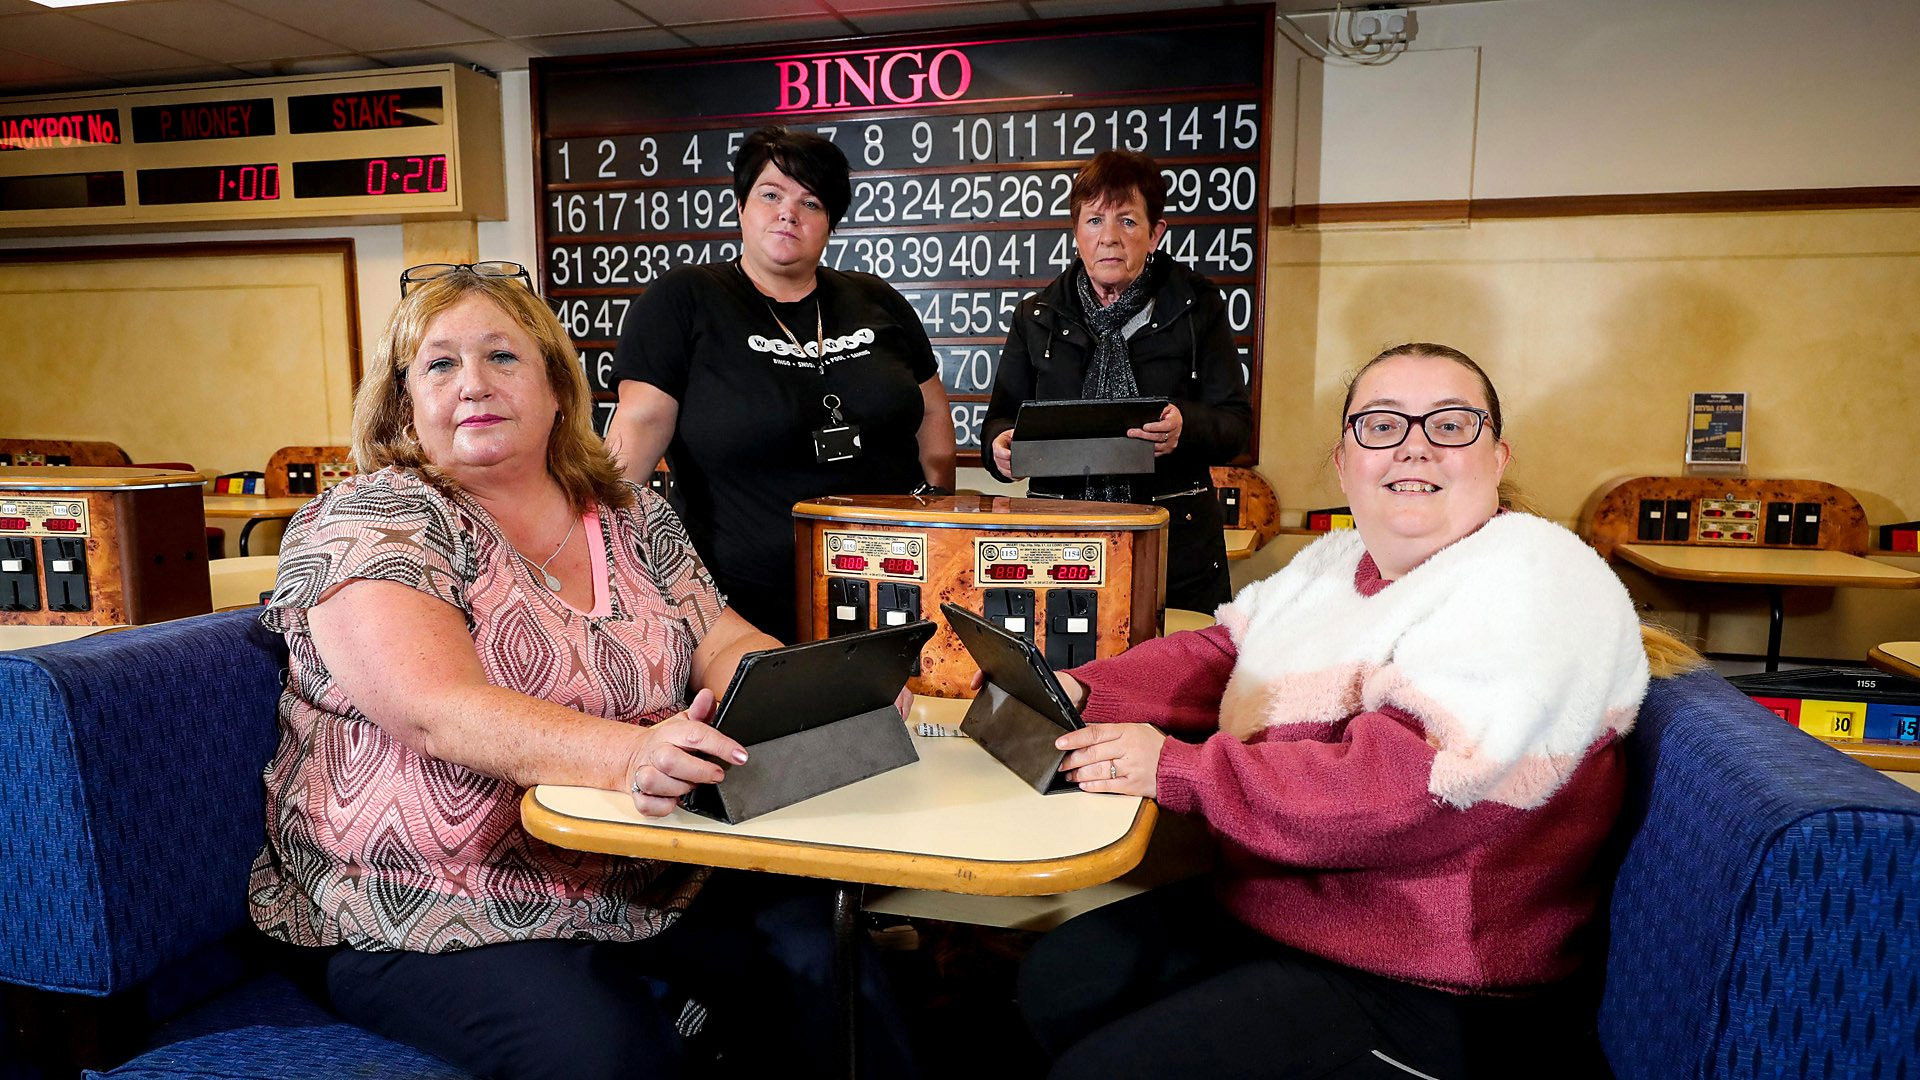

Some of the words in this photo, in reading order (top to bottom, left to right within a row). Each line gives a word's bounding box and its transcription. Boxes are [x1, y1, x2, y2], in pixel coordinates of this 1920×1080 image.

[775, 49, 973, 111] BINGO
[0, 116, 84, 150] JACKPOT
[87, 113, 119, 144] No.
[159, 110, 176, 139] P.
[181, 104, 252, 137] MONEY
[332, 95, 403, 130] STAKE
[558, 141, 570, 180] 1
[598, 139, 617, 178] 2
[639, 137, 659, 177] 3
[682, 134, 703, 174] 4
[863, 124, 885, 167] 8
[911, 121, 933, 164] 9
[952, 117, 993, 161] 10
[1001, 114, 1037, 158] 11
[1053, 112, 1096, 155] 12
[1105, 110, 1148, 152] 13
[1158, 107, 1203, 151] 14
[1212, 104, 1257, 149] 15
[552, 194, 587, 233] 16
[592, 192, 628, 231] 17
[634, 191, 670, 231] 18
[677, 189, 713, 229] 19
[719, 188, 739, 228] 2
[854, 181, 896, 223] 23
[902, 178, 945, 221] 24
[949, 176, 994, 219] 25
[998, 174, 1044, 218] 26
[1050, 174, 1078, 216] 2
[1161, 168, 1202, 213] 29
[1207, 166, 1256, 212] 30
[552, 247, 583, 285] 31
[592, 246, 629, 284] 32
[633, 244, 671, 284] 33
[854, 237, 896, 279] 38
[901, 236, 945, 279] 39
[948, 234, 992, 277] 40
[997, 233, 1036, 276] 41
[1048, 232, 1079, 273] 4
[1205, 227, 1253, 272] 45
[556, 300, 590, 338] 46
[595, 299, 631, 337] 47
[950, 291, 993, 334] 55
[753, 331, 868, 354] WESTWAY
[773, 358, 791, 367] BINGO
[950, 349, 993, 391] 70
[951, 405, 989, 446] 85
[1064, 550, 1080, 558] 1154
[1857, 680, 1876, 688] 1155
